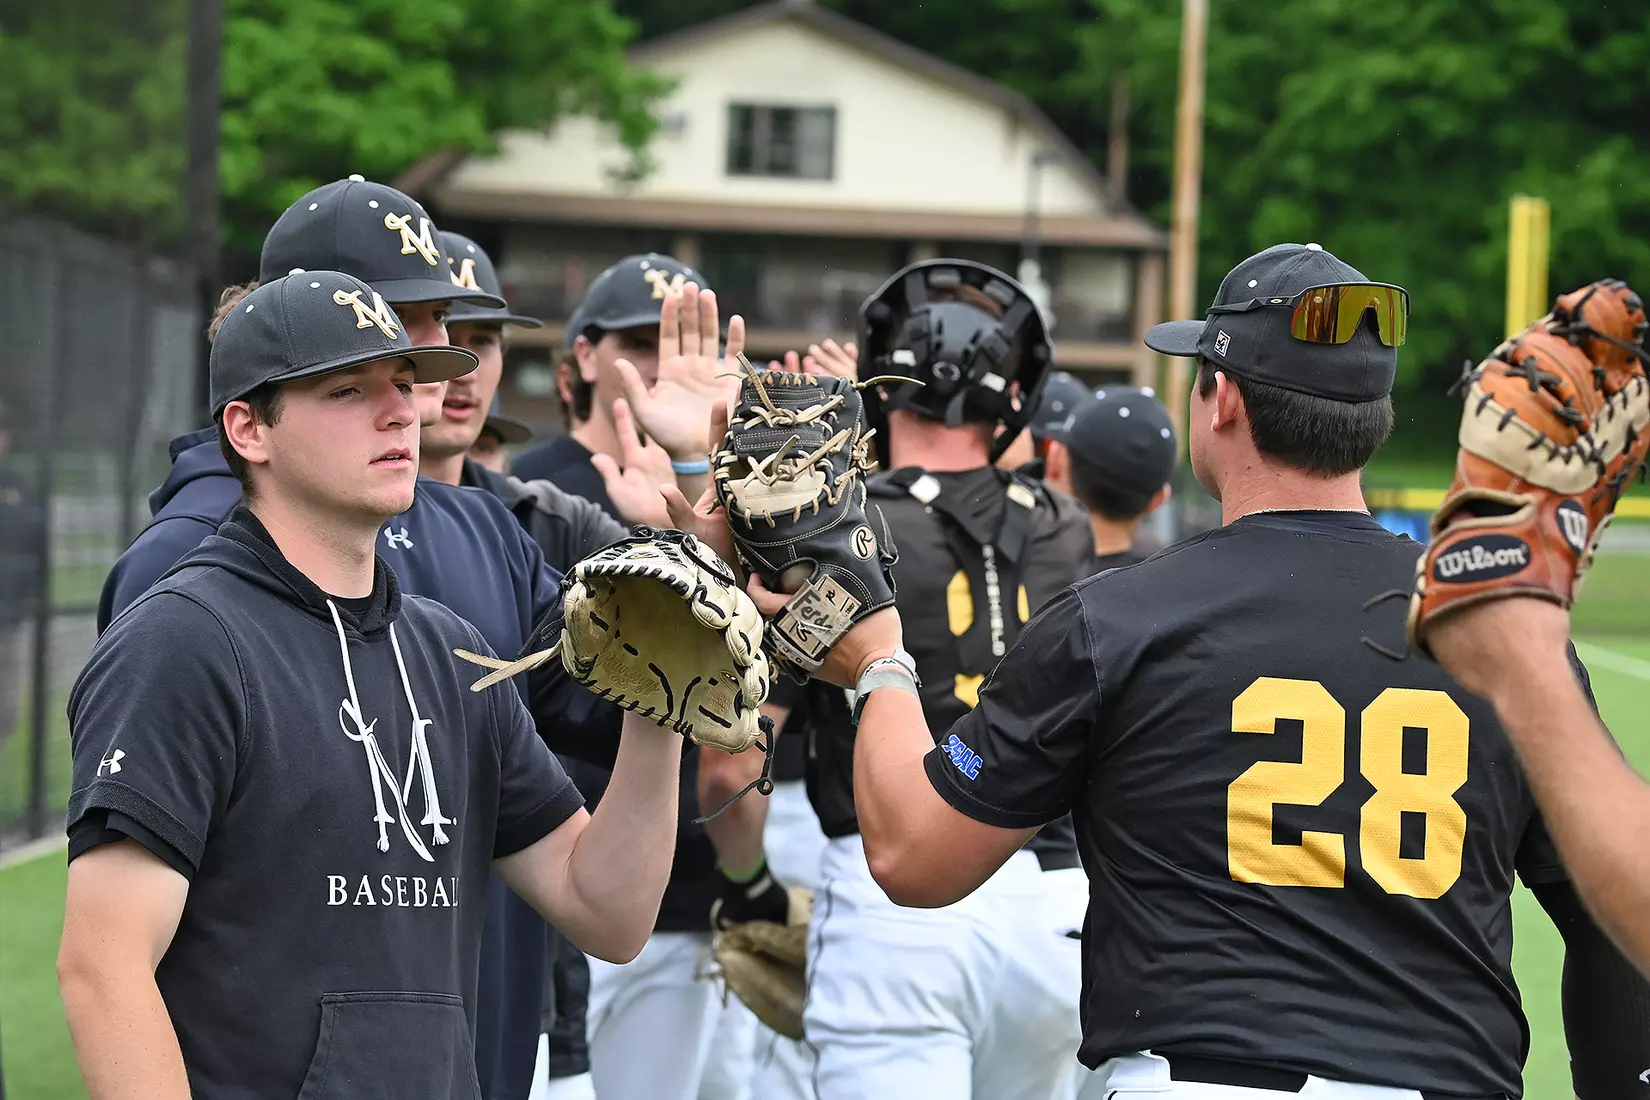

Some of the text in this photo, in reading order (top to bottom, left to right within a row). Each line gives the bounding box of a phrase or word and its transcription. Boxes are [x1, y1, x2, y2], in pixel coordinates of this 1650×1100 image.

[384, 211, 441, 266] M
[332, 289, 402, 340] M
[1436, 545, 1527, 577] Wilson
[1226, 676, 1471, 900] 28
[326, 874, 460, 907] BASEBAL
